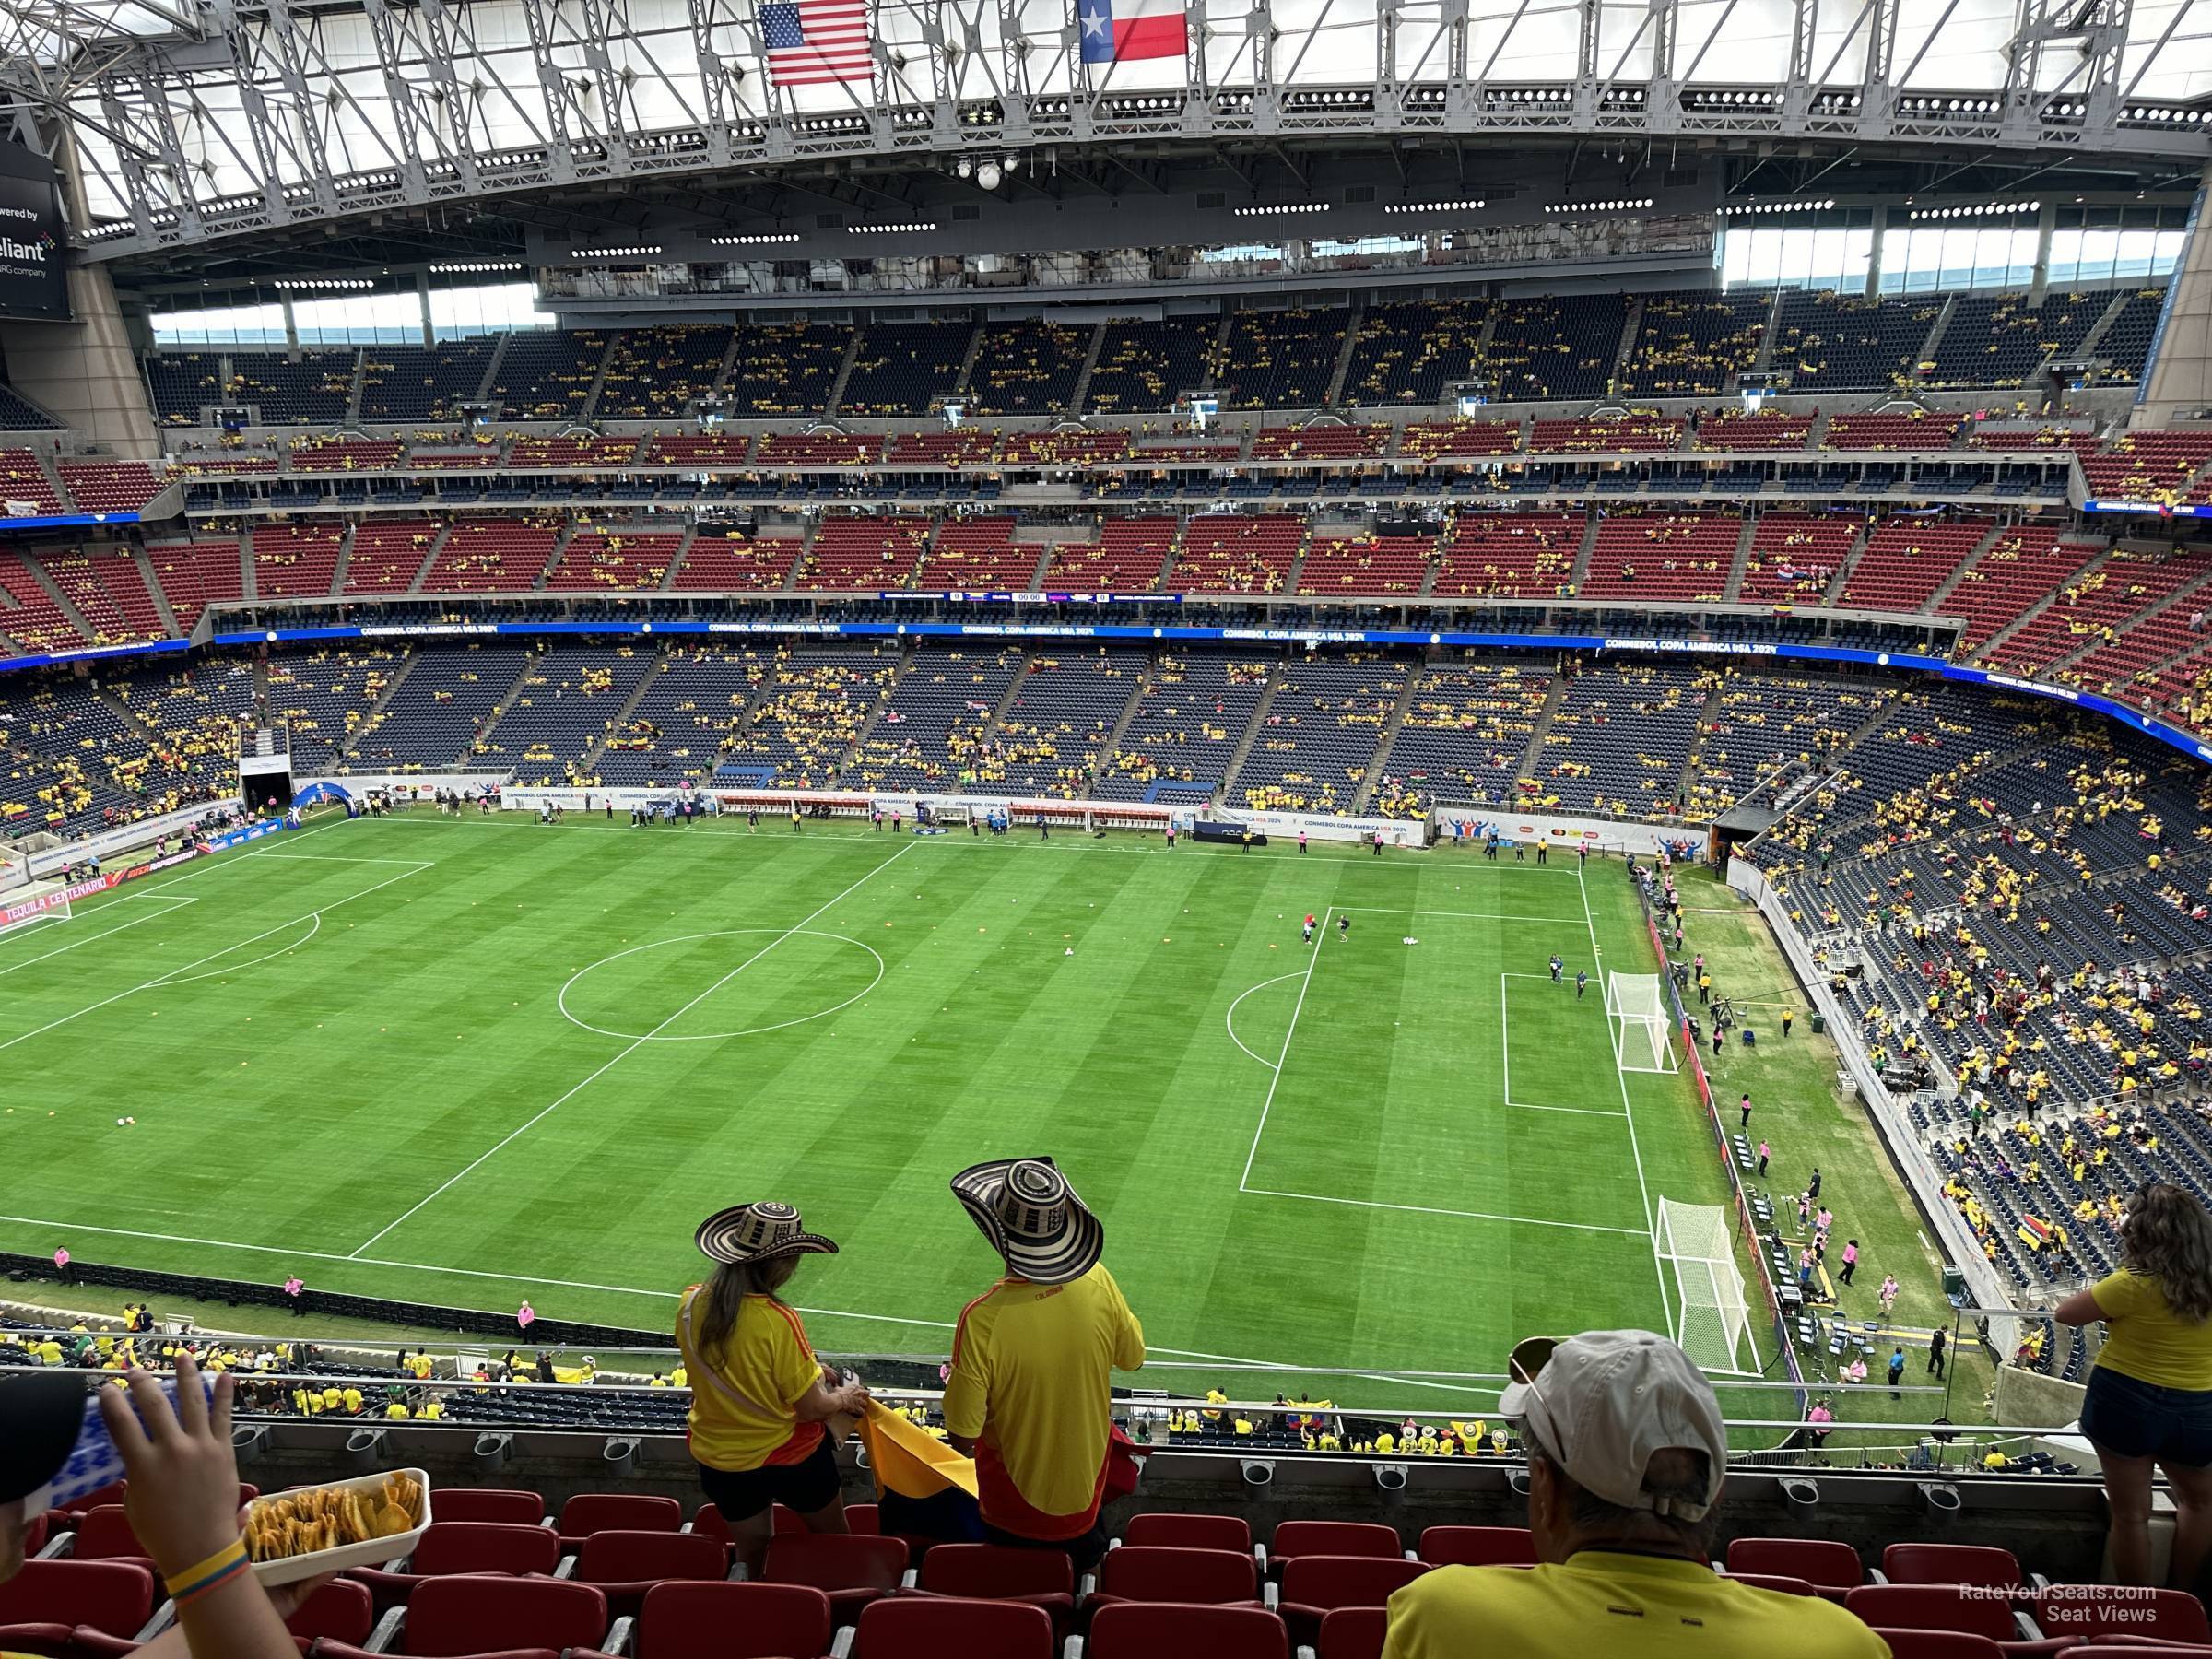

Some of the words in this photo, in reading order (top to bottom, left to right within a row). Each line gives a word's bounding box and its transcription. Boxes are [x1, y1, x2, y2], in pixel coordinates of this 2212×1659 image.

[27, 209, 38, 221] by
[13, 267, 47, 278] company
[361, 627, 406, 636] CONMEBOL
[428, 626, 462, 634] AMERICA
[708, 624, 751, 632] CONMEBOL
[772, 624, 806, 632] AMERICA
[962, 626, 1005, 634] CONMEBOL
[1025, 627, 1060, 635] AMERICA
[1223, 629, 1267, 639] CONMEBOL
[1267, 630, 1290, 639] COPA
[1290, 631, 1327, 640] AMERICA
[1605, 639, 1658, 649] CONMEBOL
[1659, 641, 1686, 650] COPA
[1686, 641, 1731, 653] AMERICA
[1732, 643, 1751, 653] USA
[1752, 645, 1778, 654] 2024
[6, 897, 45, 920] TEQUILA
[49, 877, 107, 905] CENTENARIO
